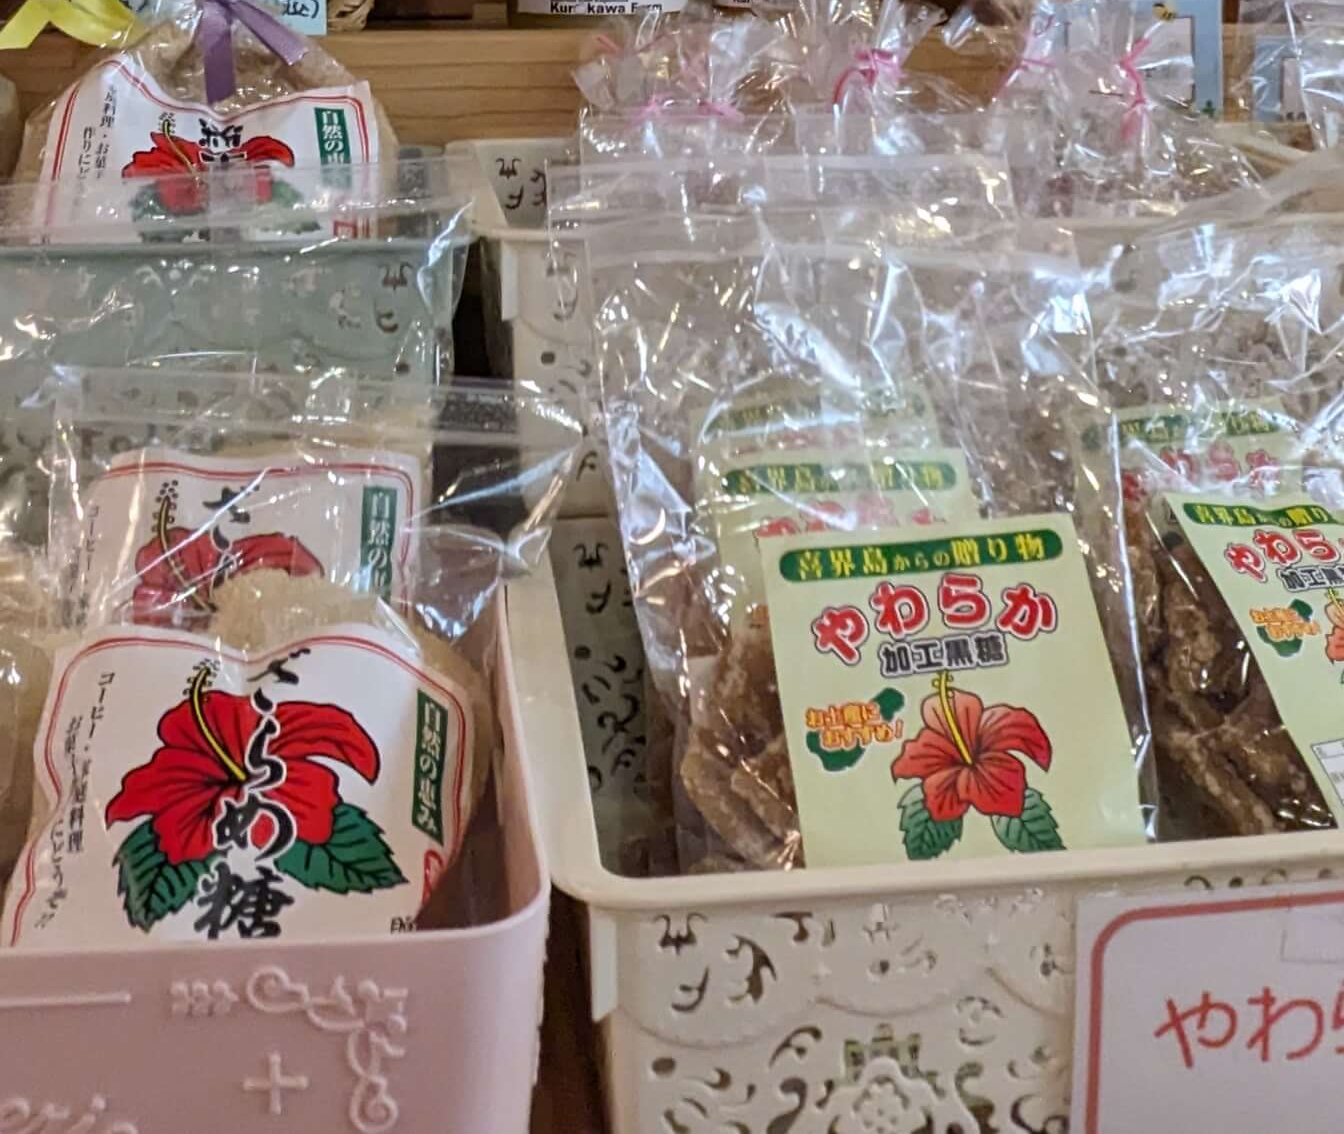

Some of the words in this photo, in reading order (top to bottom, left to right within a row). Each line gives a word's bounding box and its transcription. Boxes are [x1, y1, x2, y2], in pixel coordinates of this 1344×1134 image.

[550, 2, 626, 15] Kurkawa
[631, 2, 662, 14] Frm
[796, 533, 1047, 580] 喜界島からの贈り物
[810, 572, 1057, 664] やわらか
[879, 633, 1008, 677] 加工黒糖
[193, 648, 312, 940] ざらめ糖
[416, 698, 447, 834] 自然の恵み
